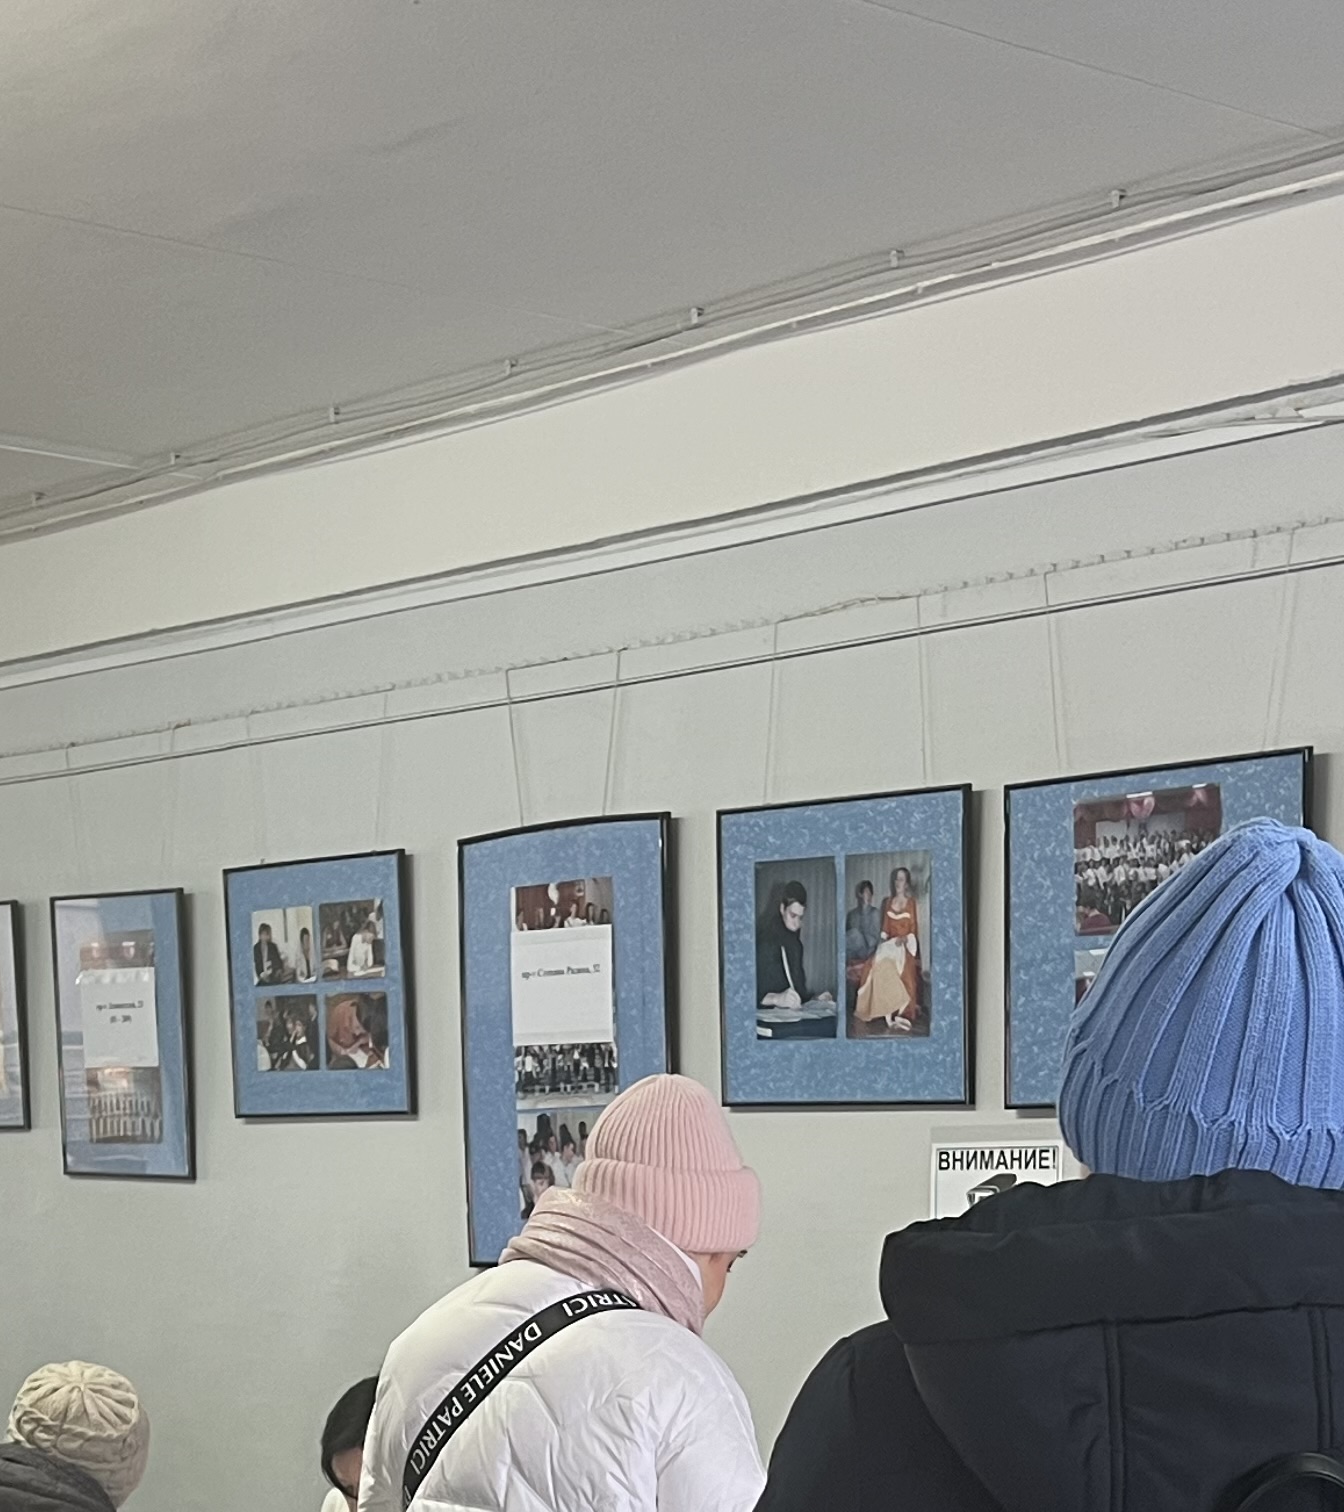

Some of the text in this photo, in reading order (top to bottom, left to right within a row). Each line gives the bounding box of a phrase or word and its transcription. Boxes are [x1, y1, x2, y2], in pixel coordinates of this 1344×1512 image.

[938, 1149, 1057, 1171] ВНИМАНИЕ!
[460, 1322, 543, 1404] DANIELE
[409, 1396, 465, 1475] PATRICI
